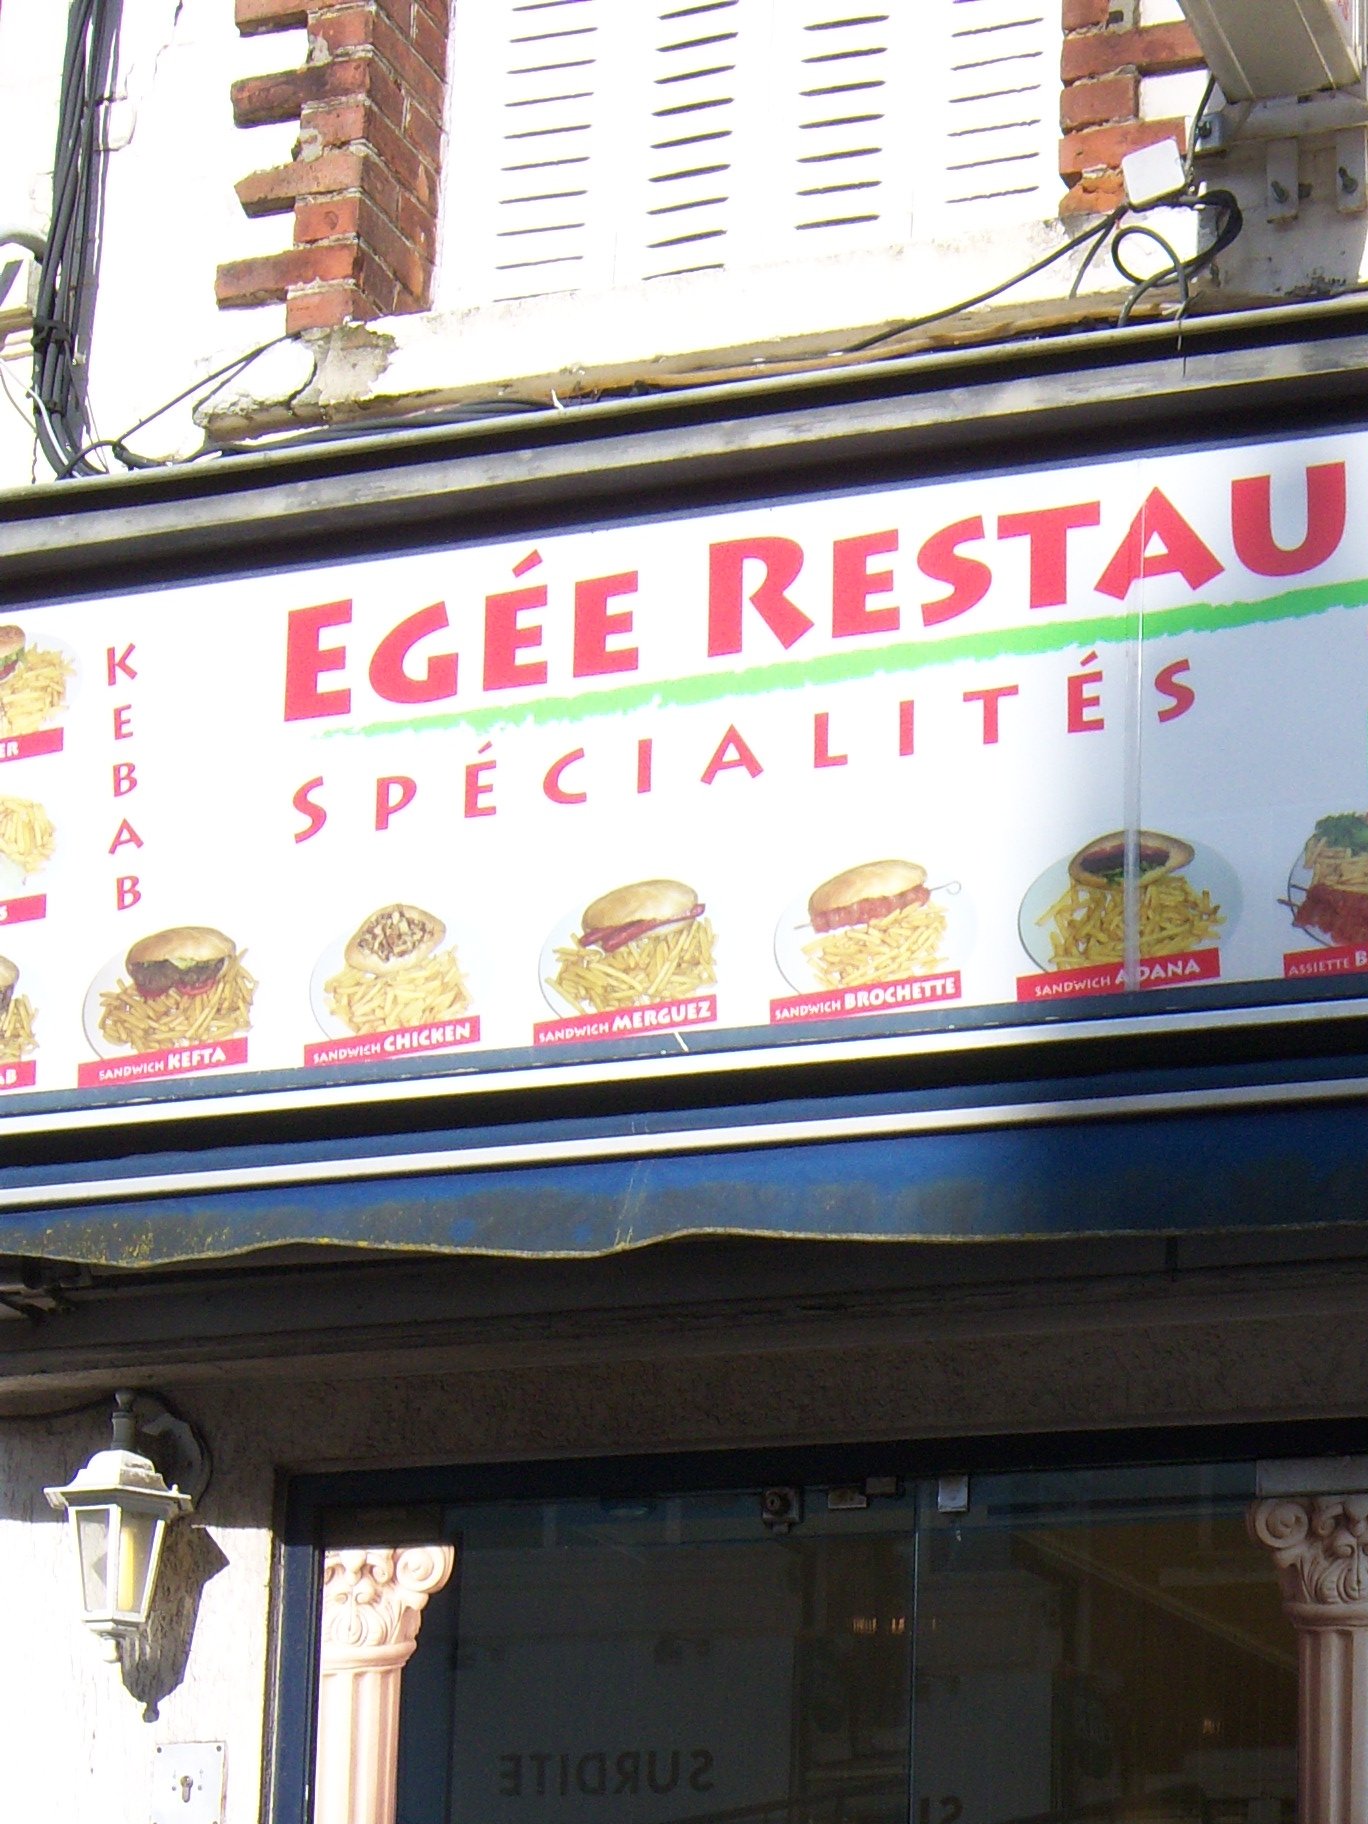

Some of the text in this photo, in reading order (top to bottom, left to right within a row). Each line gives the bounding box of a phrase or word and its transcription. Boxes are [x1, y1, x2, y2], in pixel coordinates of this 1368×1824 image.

[284, 548, 640, 721] EGÉE
[293, 651, 1195, 844] SPÉCIALITÉS
[106, 643, 144, 911] KEBAB
[1034, 975, 1111, 997] SANDWICH
[1288, 958, 1350, 977] ASSIETTE
[775, 977, 957, 1020] SANDWICH BROCHETTE
[538, 1000, 712, 1043] SANDWICH MERGUEZ
[98, 1047, 227, 1080] SANDWICH KEFTA
[312, 1023, 471, 1064] SANDWICH CHICKEN
